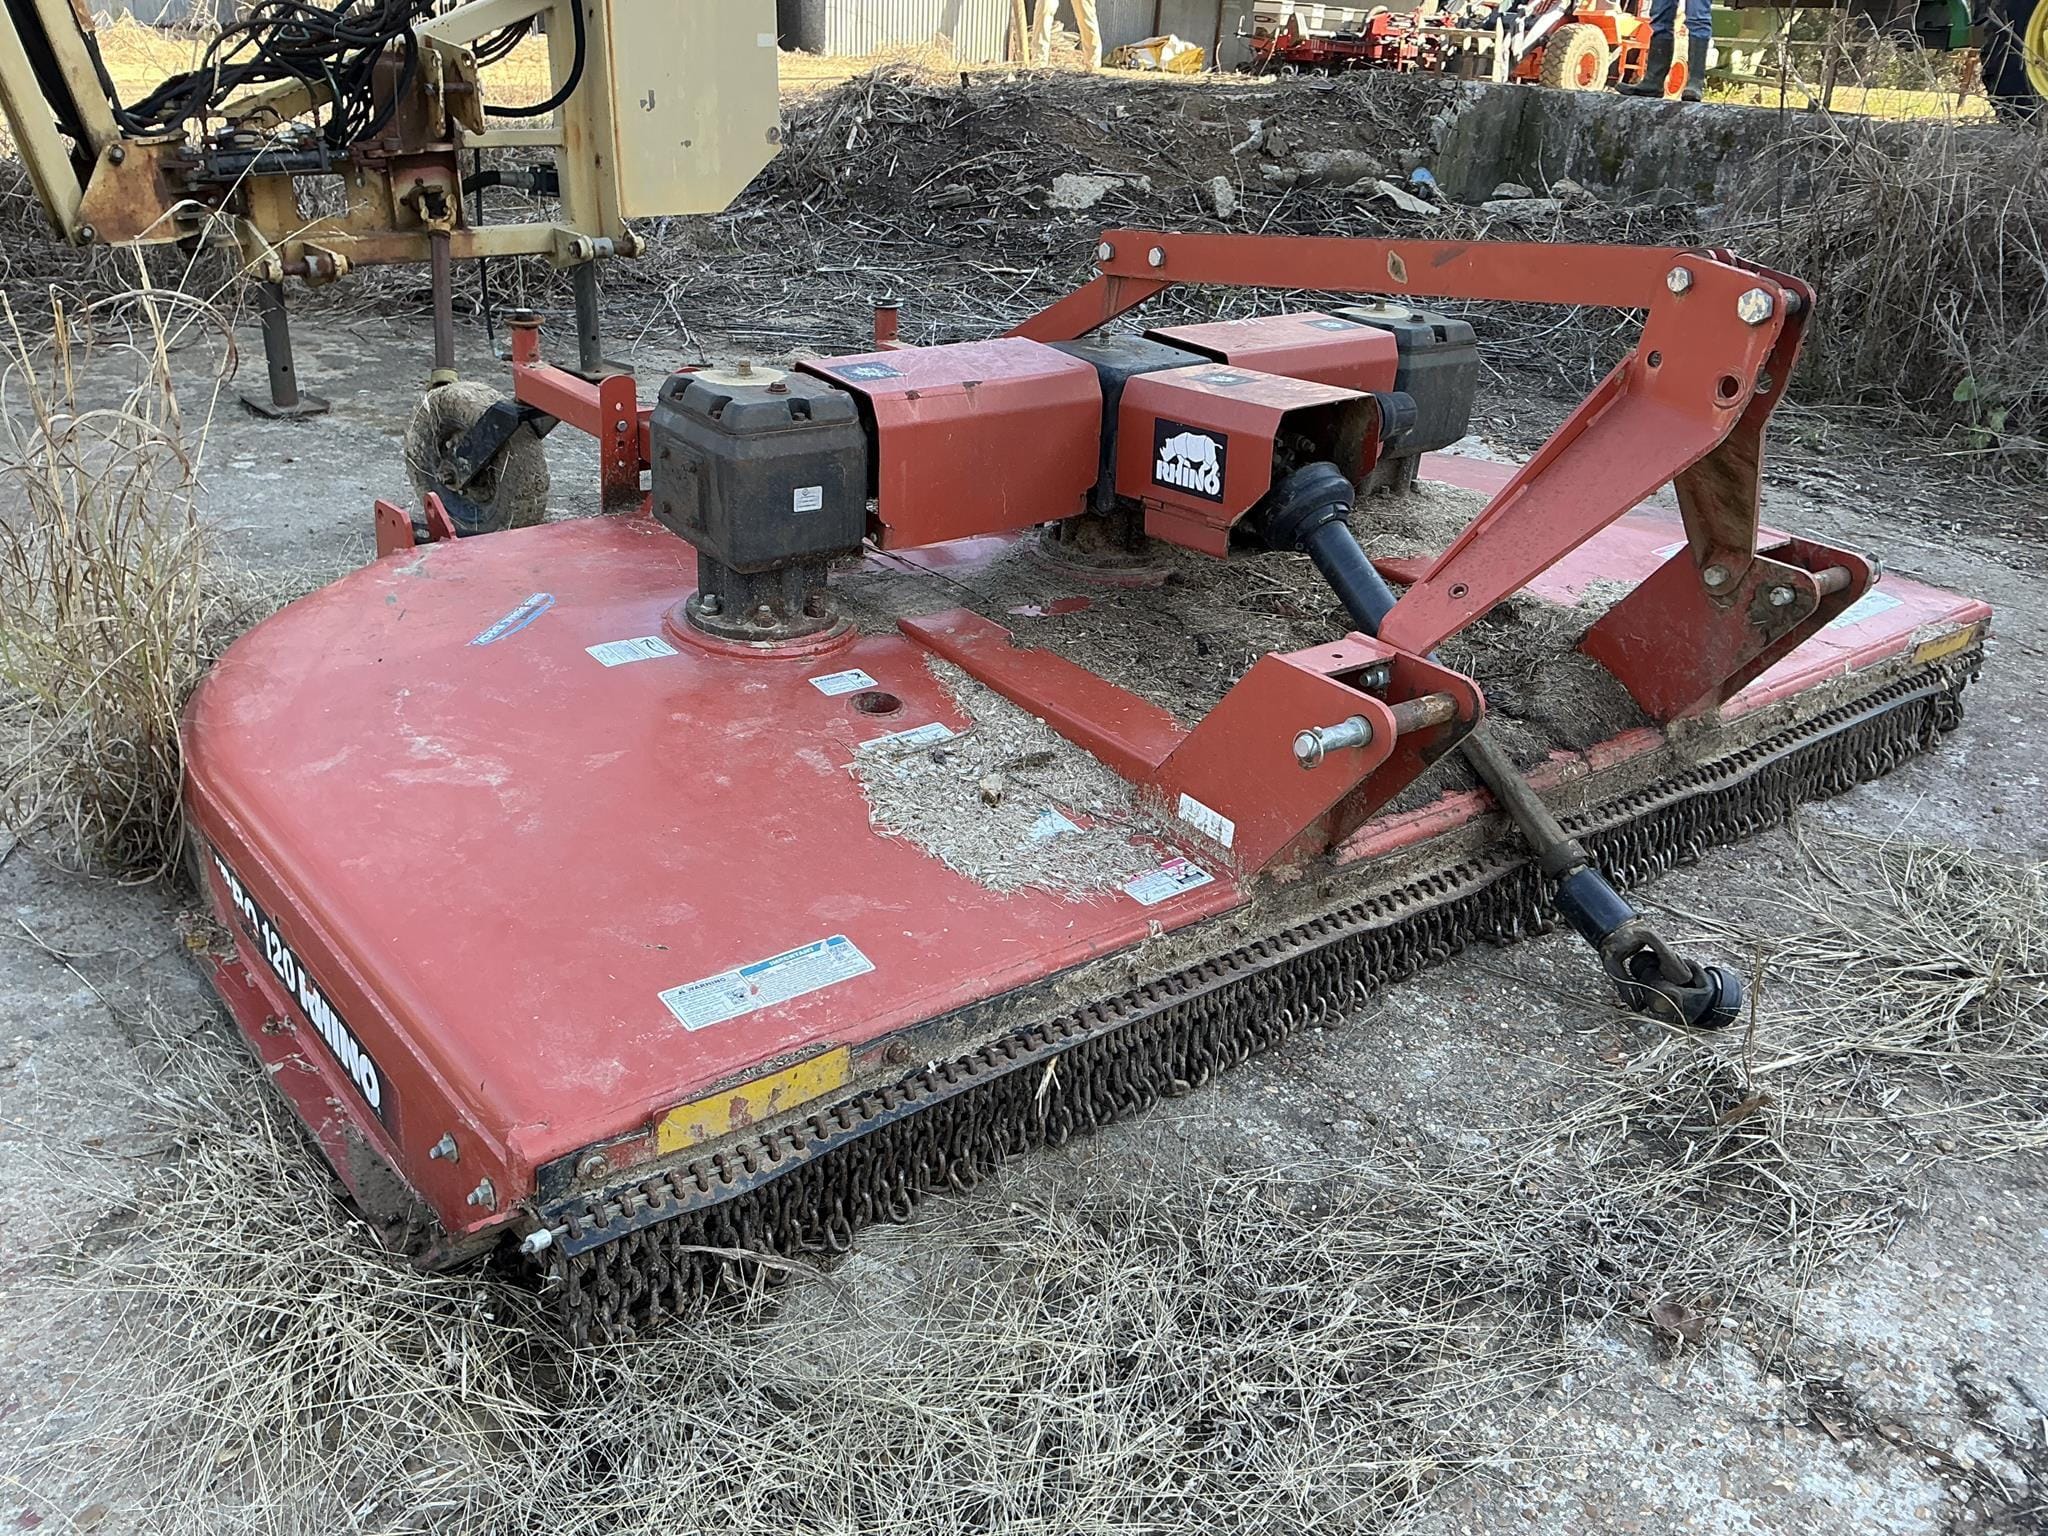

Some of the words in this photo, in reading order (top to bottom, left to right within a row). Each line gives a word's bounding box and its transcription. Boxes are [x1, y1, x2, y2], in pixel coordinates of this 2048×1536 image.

[1156, 460, 1221, 495] RHINO
[768, 946, 815, 967] IMPORTANT
[688, 977, 727, 992] WARNING
[262, 920, 297, 993] 120
[297, 966, 382, 1109] RHINO
